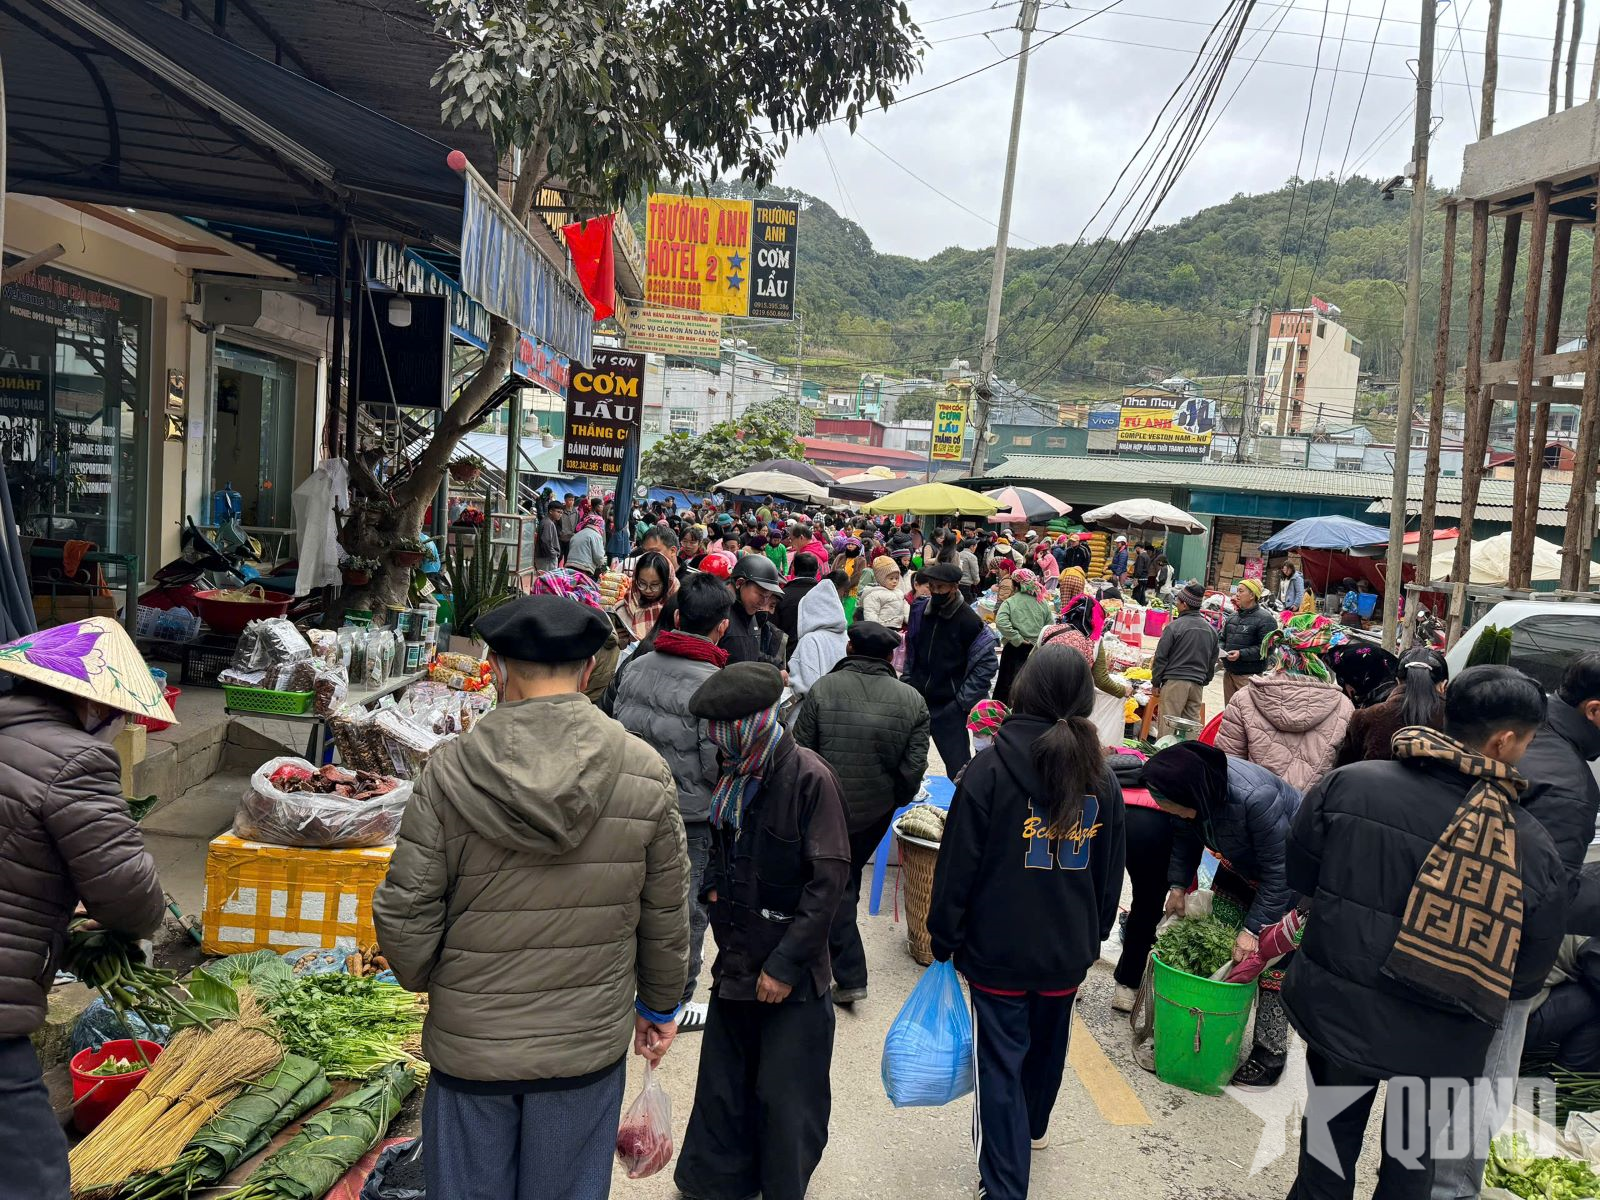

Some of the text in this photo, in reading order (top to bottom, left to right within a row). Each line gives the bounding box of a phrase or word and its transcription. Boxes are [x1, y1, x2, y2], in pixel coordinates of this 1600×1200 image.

[716, 210, 749, 247] ANH
[765, 226, 786, 242] ANH
[648, 240, 699, 280] HOTEL
[706, 256, 718, 282] 2
[758, 248, 790, 269] CƠM
[757, 270, 788, 298] LẨU
[573, 371, 639, 397] CƠM
[1150, 397, 1177, 409] May
[1145, 418, 1172, 429] ANH
[567, 441, 589, 456] BÁNH
[591, 443, 612, 458] CUỐN
